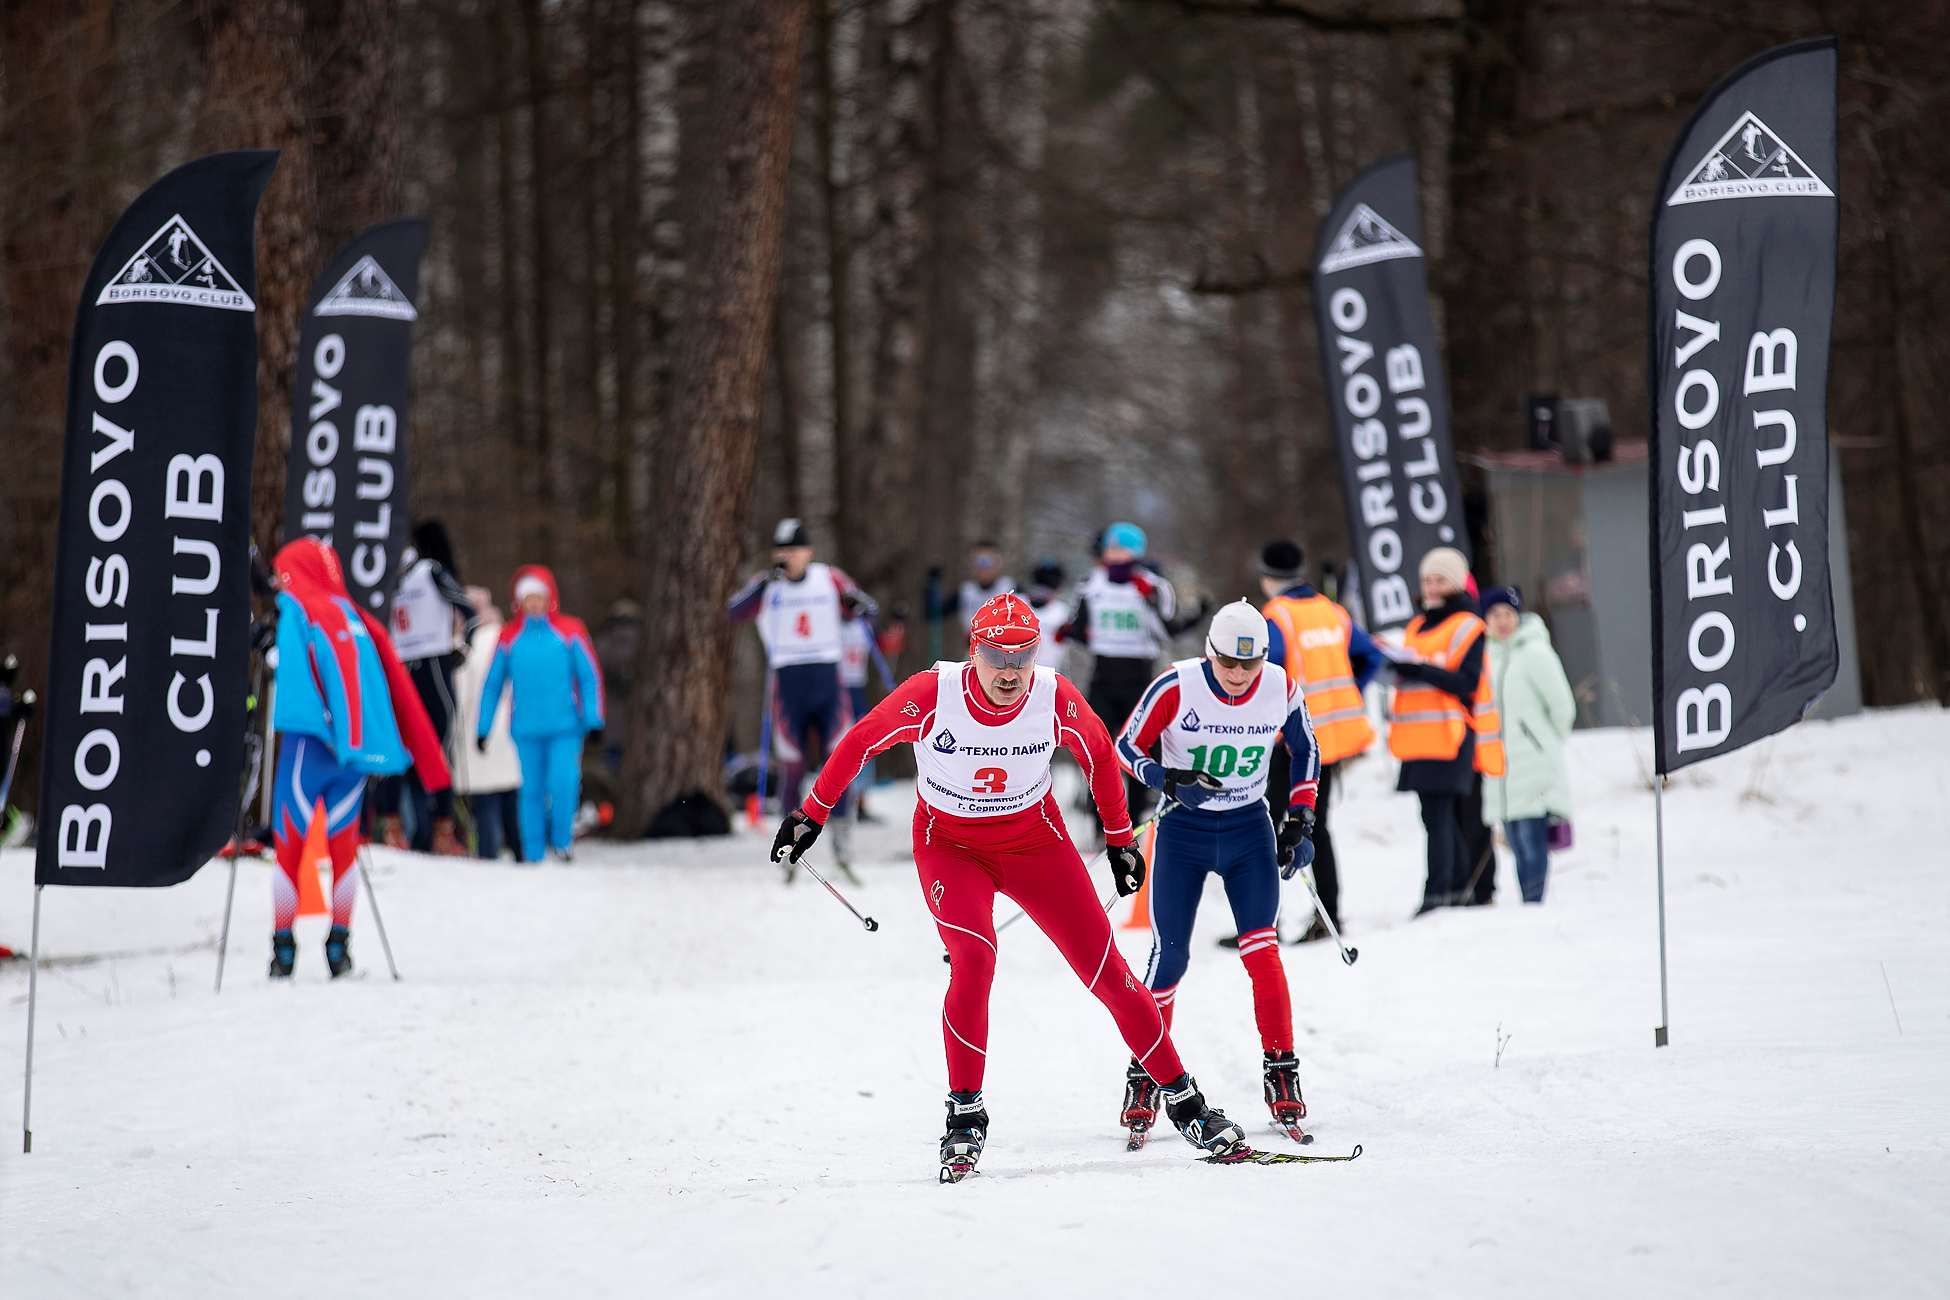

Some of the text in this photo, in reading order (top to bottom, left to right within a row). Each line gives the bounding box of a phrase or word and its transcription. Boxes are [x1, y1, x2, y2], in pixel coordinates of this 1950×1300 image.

[1685, 182, 1819, 199] BORISOVO.CLUB
[109, 288, 244, 306] BORISOVO.CLUB
[301, 333, 346, 545] ISOVO
[350, 404, 398, 609] .CLUB
[1330, 286, 1414, 625] BORISOVO
[1385, 342, 1456, 543] .CLUB
[1672, 238, 1736, 754] BORISOVO
[1742, 327, 1808, 632] .CLUB
[57, 340, 140, 870] BORISOVO
[164, 452, 226, 768] .CLUB
[987, 624, 1005, 639] 46
[971, 766, 1009, 794] 3
[1187, 744, 1266, 778] 103
